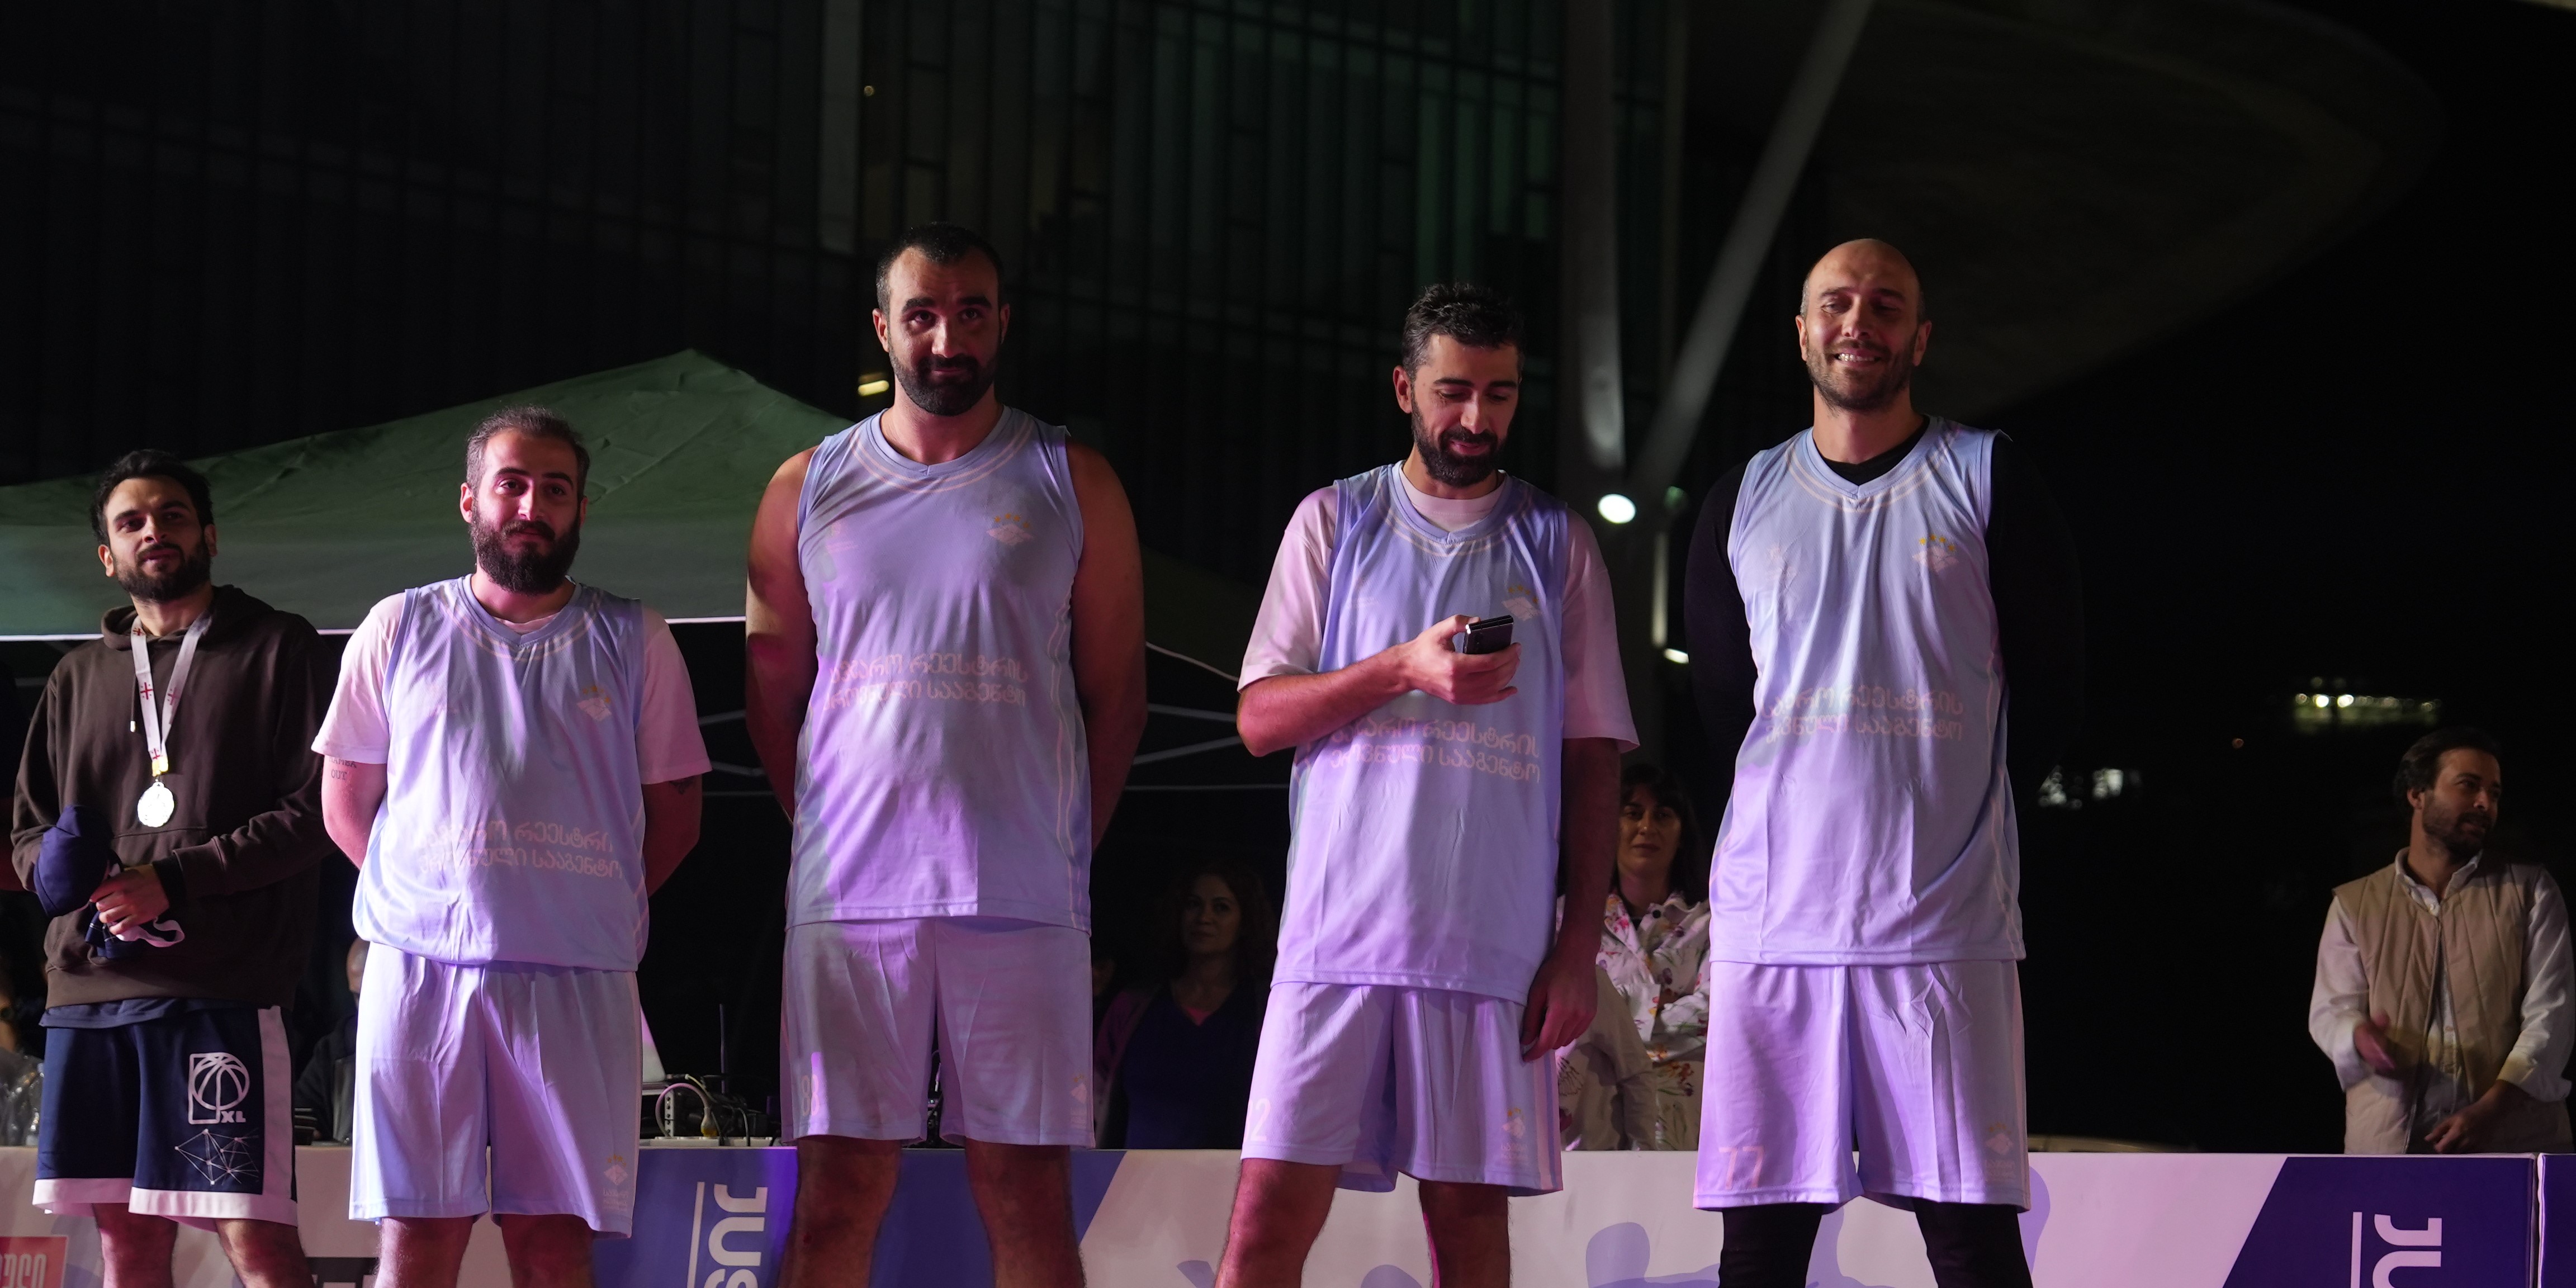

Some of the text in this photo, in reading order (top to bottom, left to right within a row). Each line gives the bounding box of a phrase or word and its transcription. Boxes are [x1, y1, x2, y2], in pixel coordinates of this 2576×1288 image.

[331, 769, 347, 780] OUT
[220, 1110, 247, 1123] XL
[1718, 1145, 1764, 1190] 77
